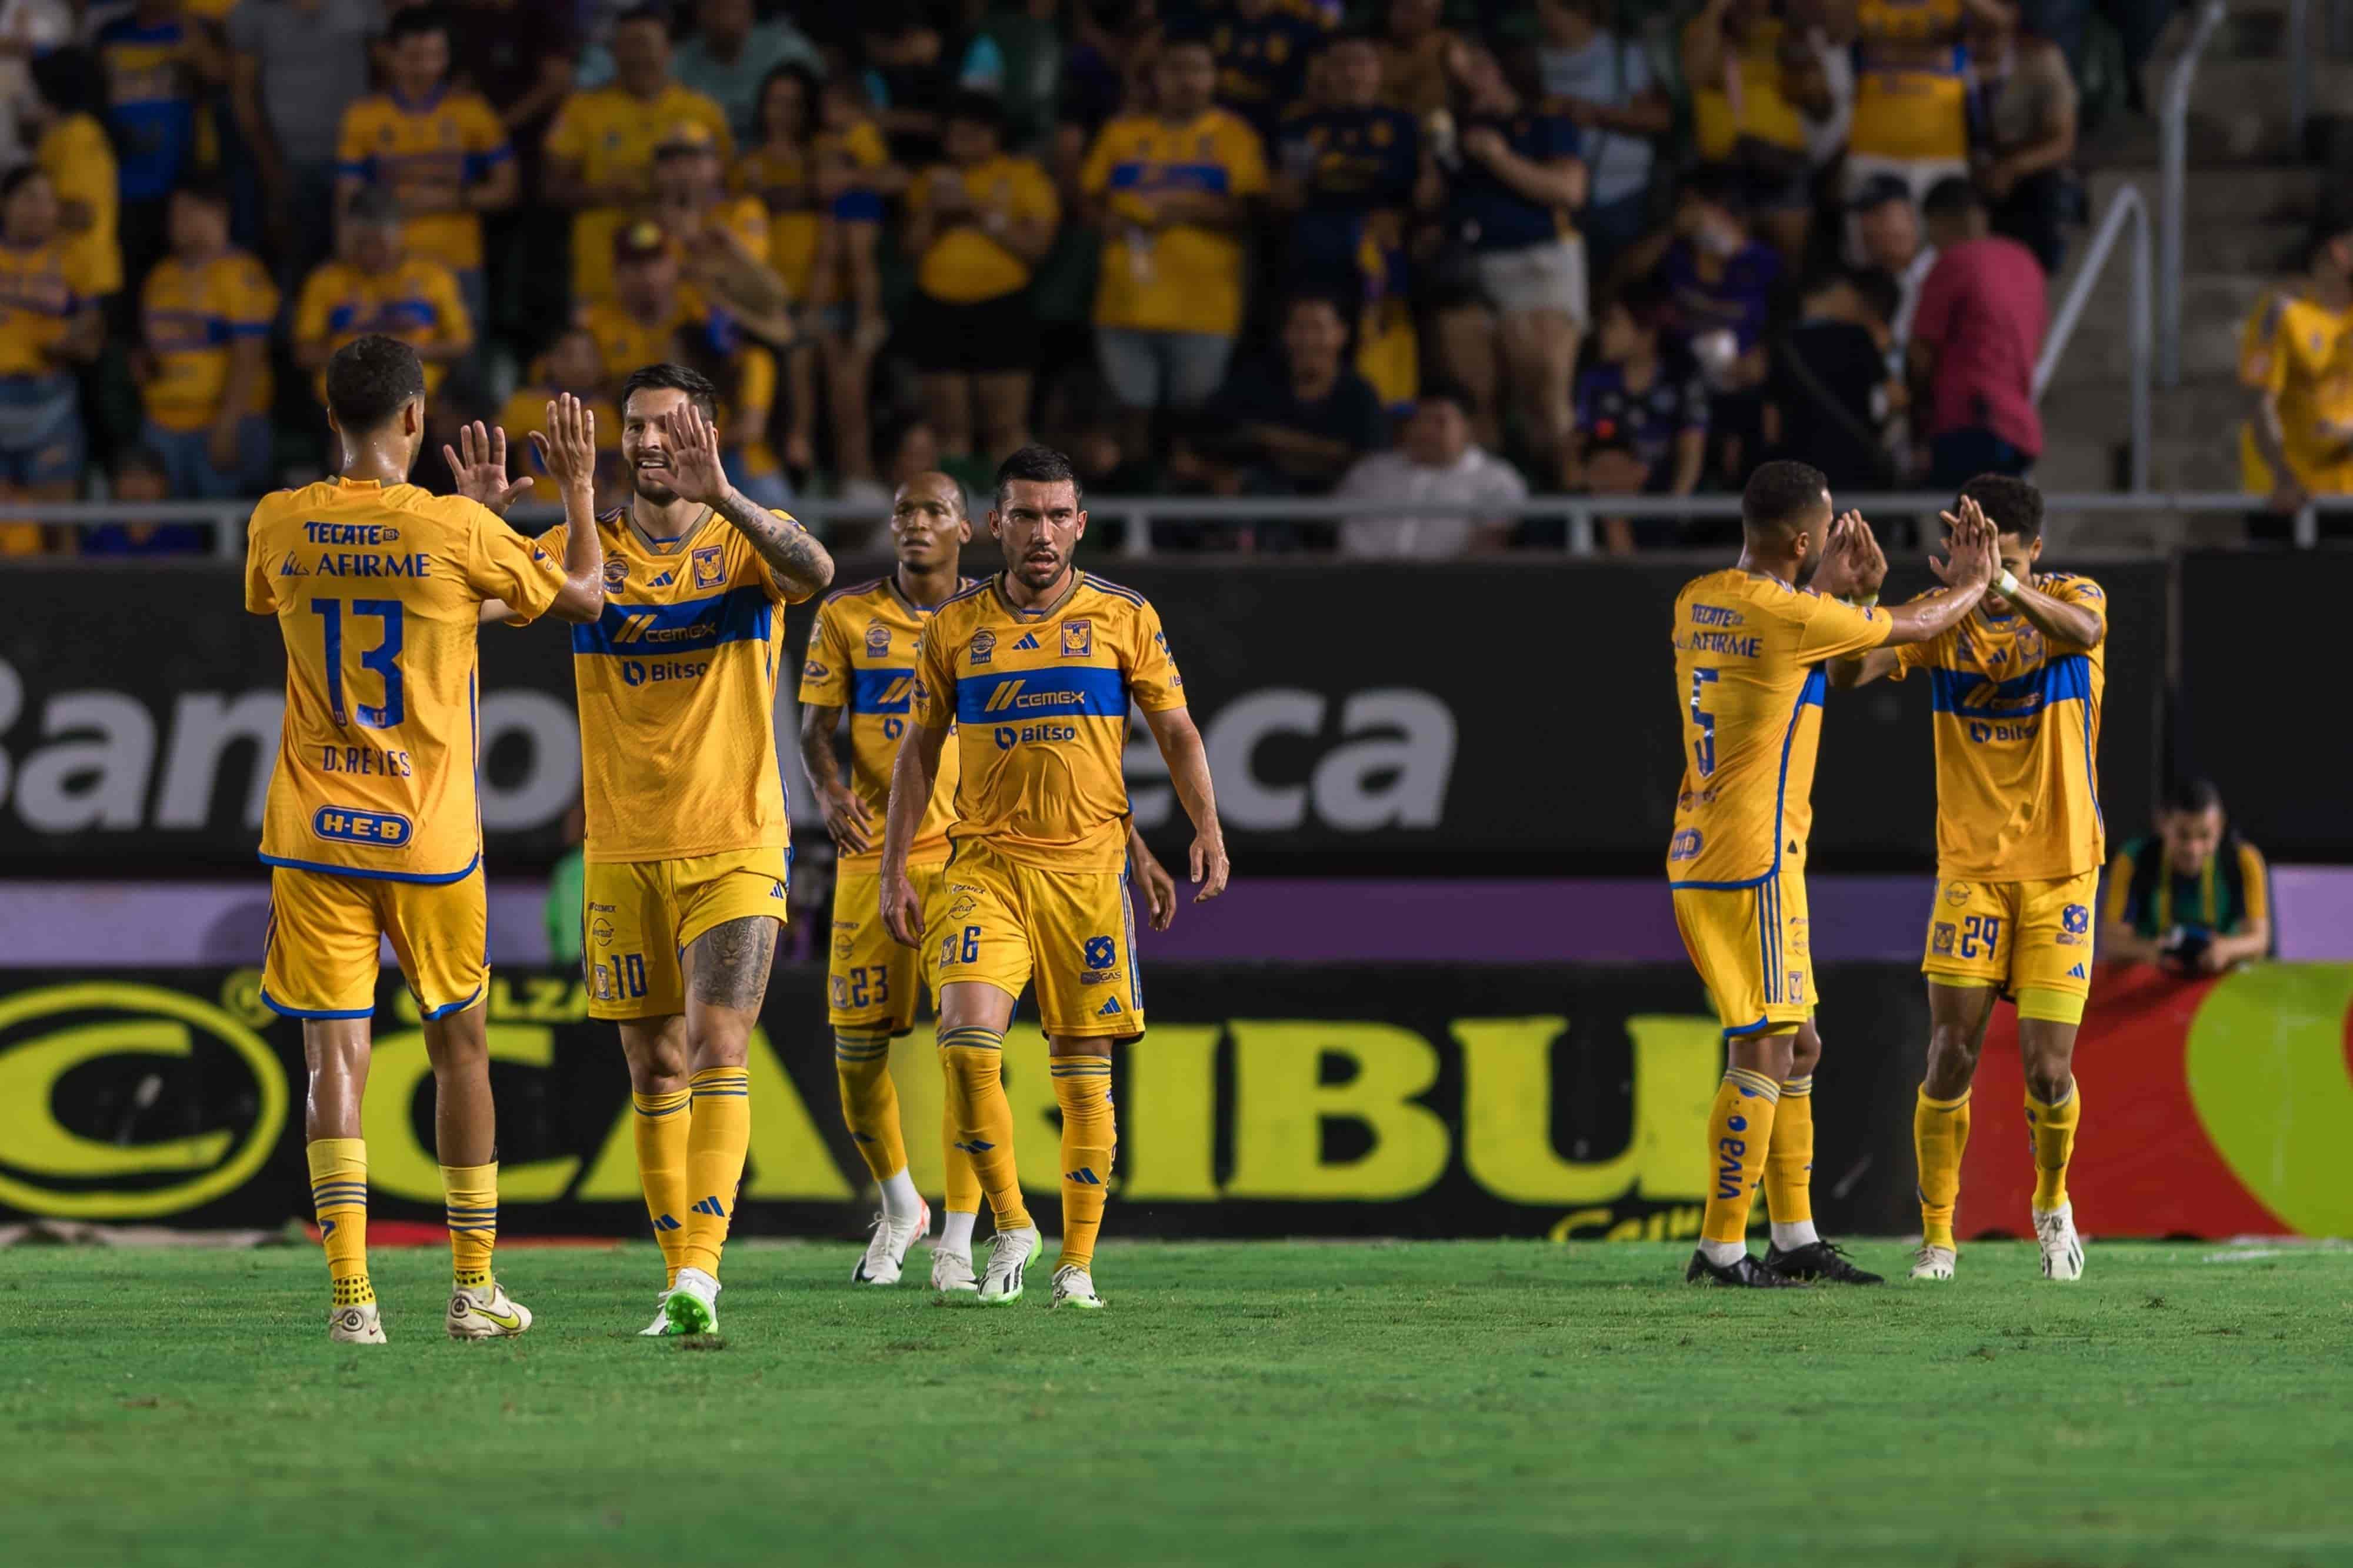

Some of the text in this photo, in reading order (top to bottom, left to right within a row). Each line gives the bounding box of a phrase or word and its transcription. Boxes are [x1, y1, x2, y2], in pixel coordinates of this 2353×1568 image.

[303, 521, 386, 545] TECATE
[316, 553, 431, 577] AFIRME
[1691, 630, 1763, 658] AFIRME
[311, 598, 405, 729] 13
[1016, 690, 1085, 707] CEMEX
[1021, 726, 1076, 743] Bitso
[1690, 667, 1719, 778] 5
[323, 745, 411, 777] D.REYES
[961, 926, 981, 963] 6
[1961, 916, 1999, 960] 29
[611, 953, 648, 999] 10
[851, 965, 889, 1007] 23
[1717, 1137, 1746, 1200] viva
